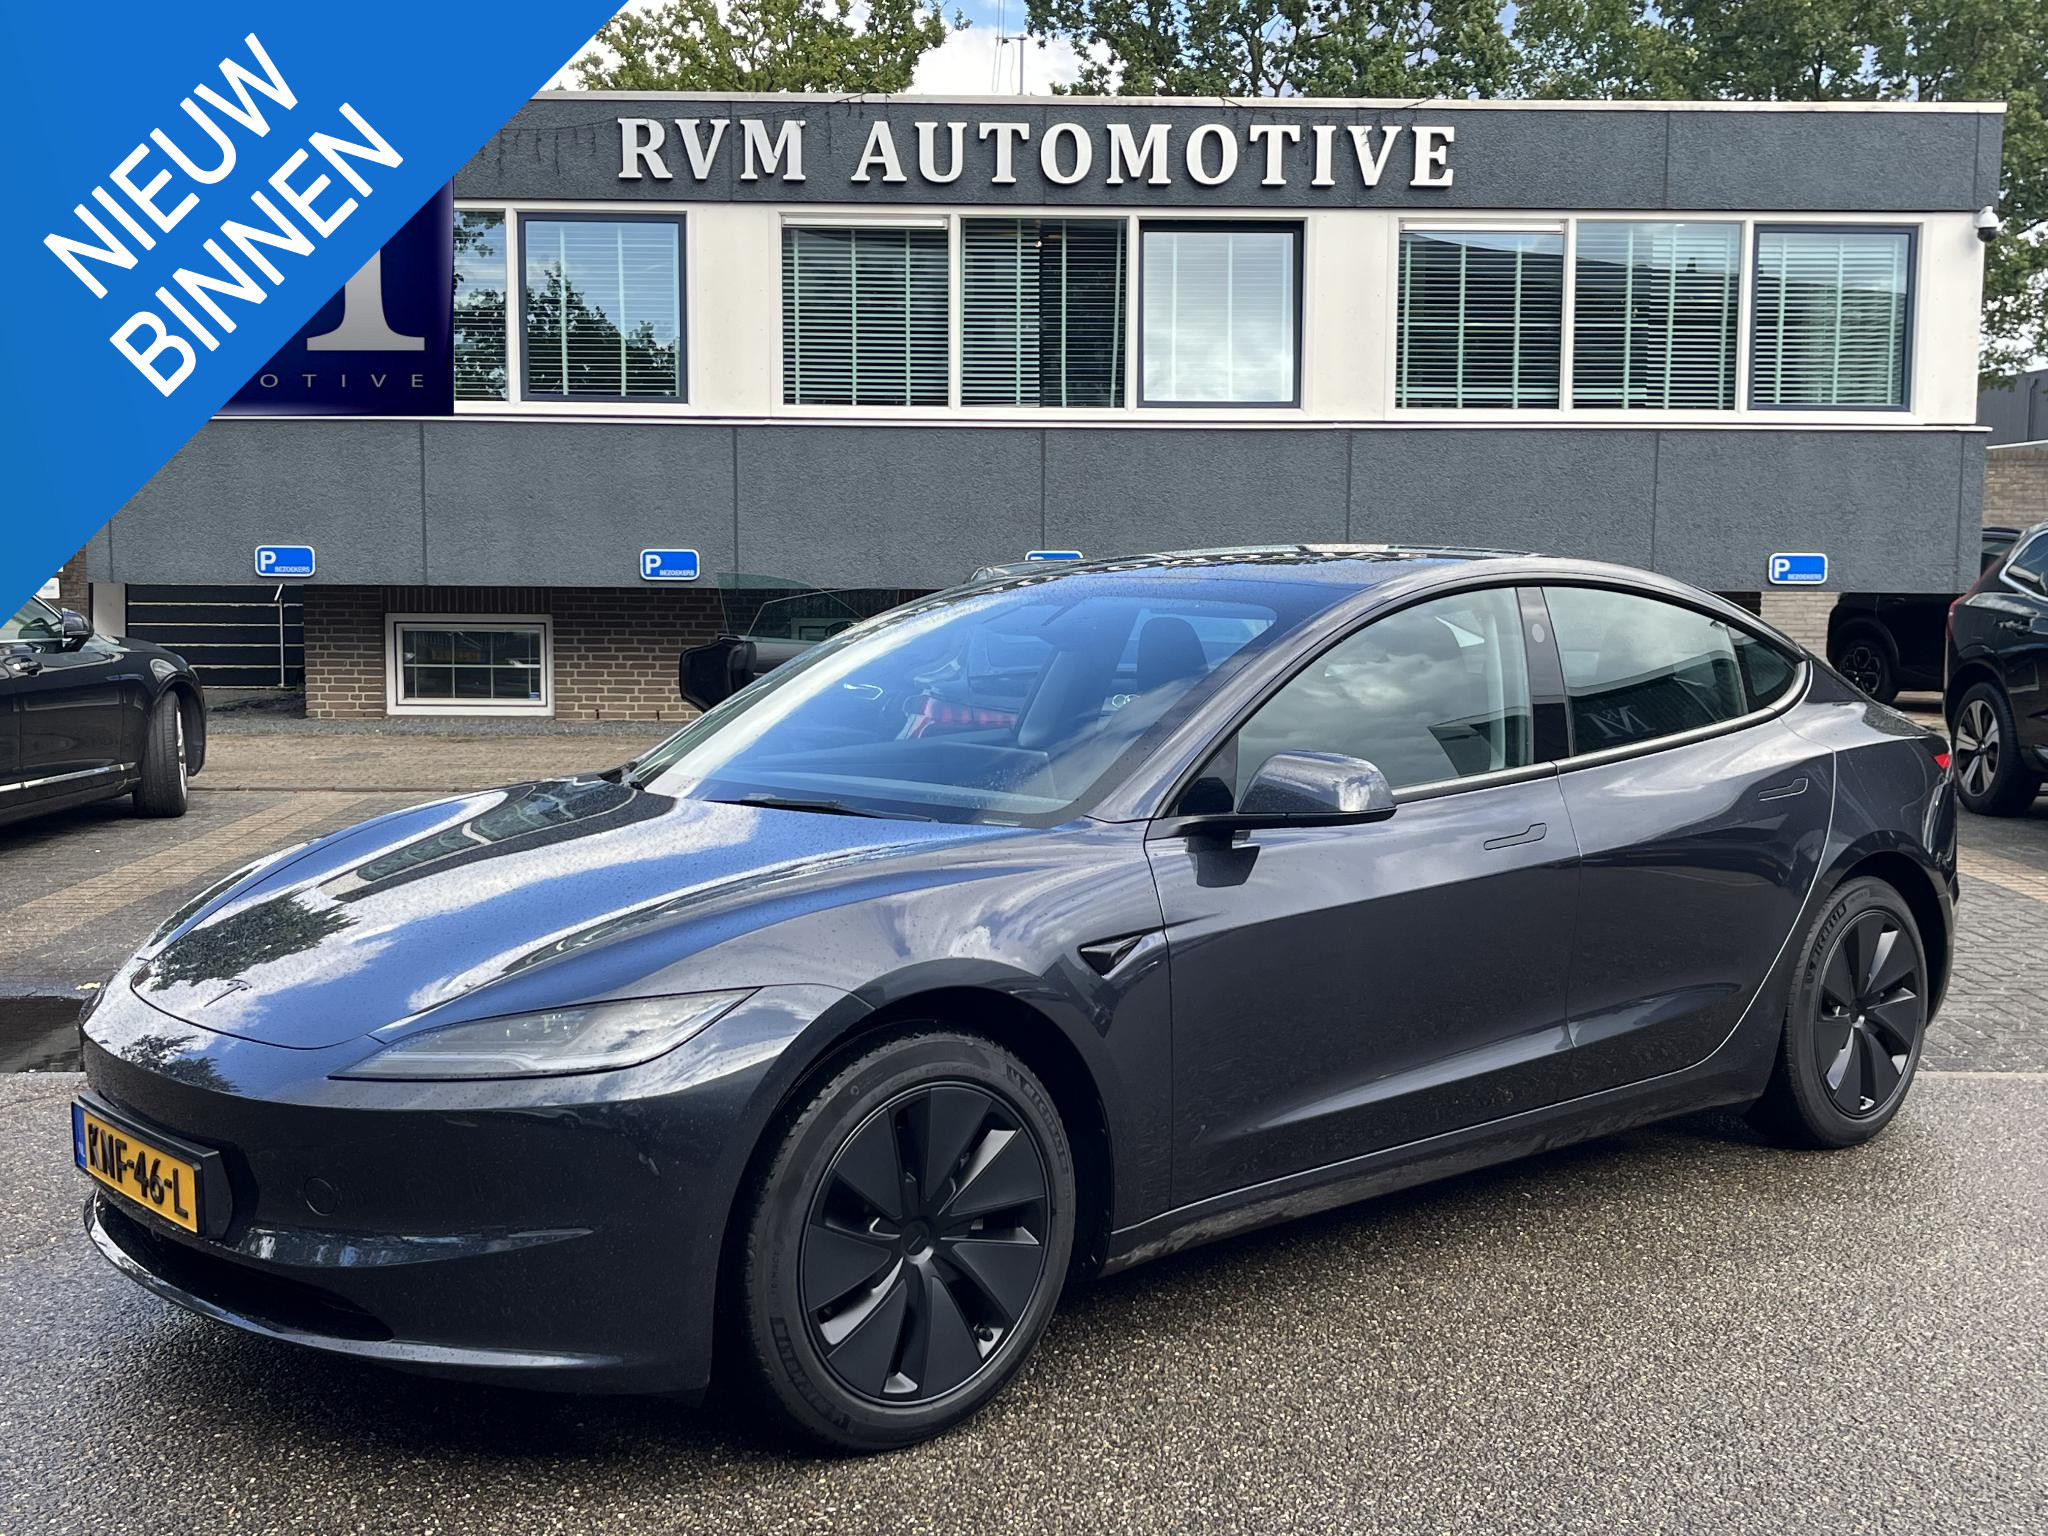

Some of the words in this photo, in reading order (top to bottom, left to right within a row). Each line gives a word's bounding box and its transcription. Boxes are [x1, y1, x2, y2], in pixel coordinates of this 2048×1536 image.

[617, 117, 807, 181] RVM
[850, 120, 1456, 187] AUTOMOTIVE
[260, 550, 277, 571] P
[645, 554, 662, 575] P
[1774, 558, 1791, 579] P
[88, 1122, 189, 1220] KNF-46-L
